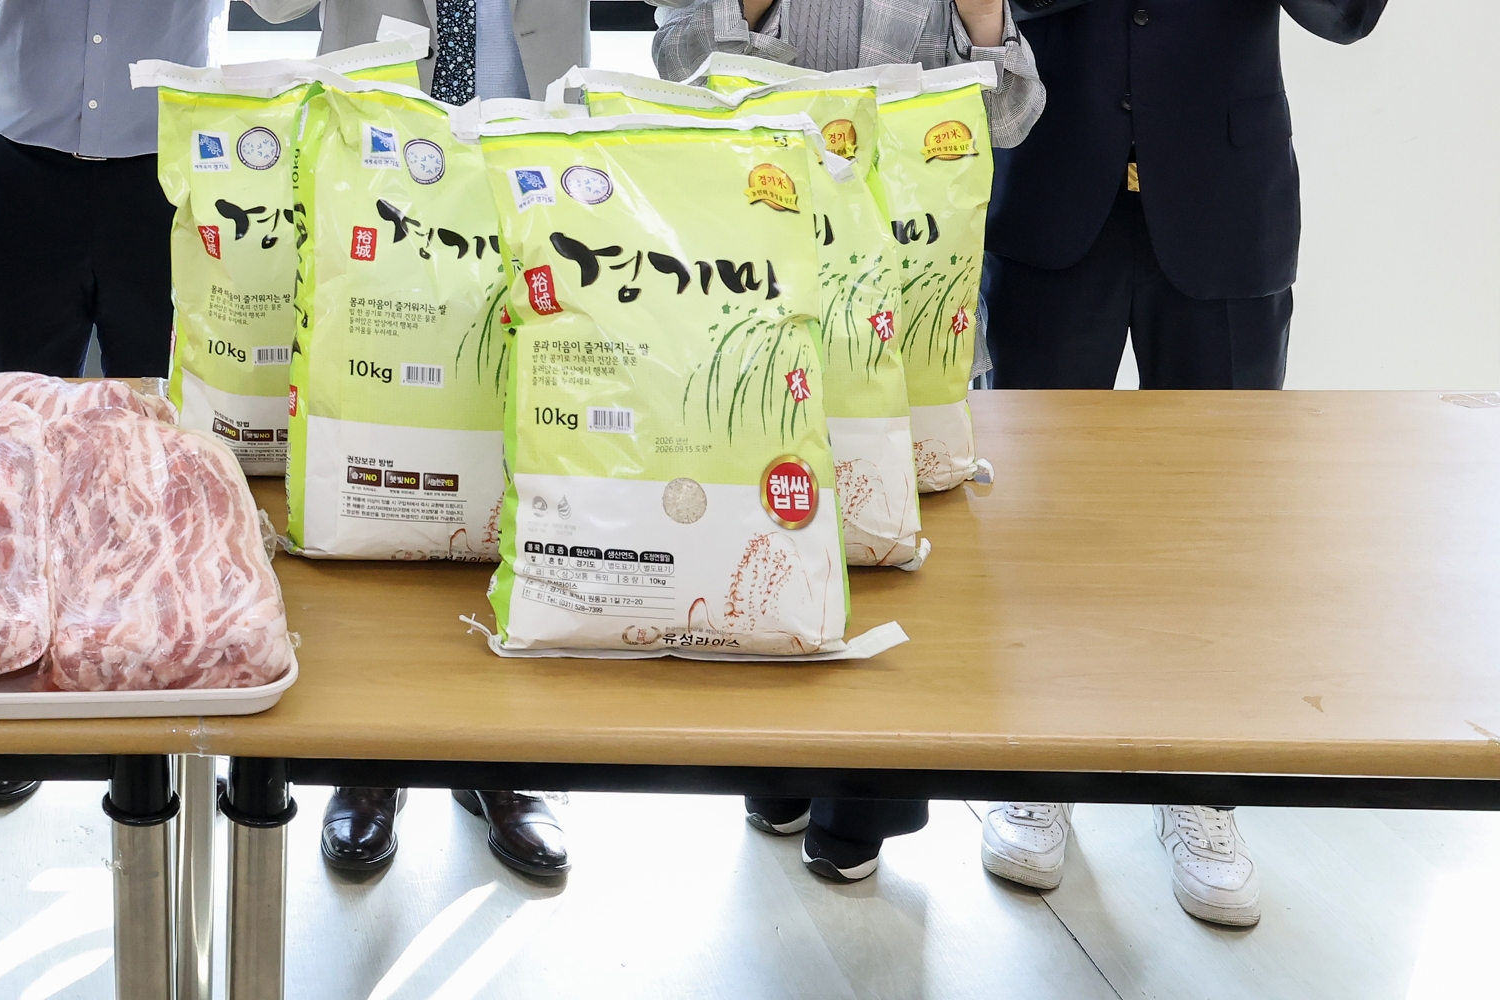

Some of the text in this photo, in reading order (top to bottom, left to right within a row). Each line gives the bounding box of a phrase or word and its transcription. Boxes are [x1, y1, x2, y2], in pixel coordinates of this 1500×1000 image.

[356, 230, 373, 259] 裕城
[549, 231, 781, 303] 경기미
[243, 294, 282, 304] 즐거워지는
[283, 293, 291, 303] 쌀
[531, 272, 556, 312] 裕城
[350, 297, 446, 315] 몸과 마음이 즐거워지는 쌀
[208, 339, 246, 363] 10kg
[533, 340, 650, 356] 몸과 마음이 즐거워지는 쌀
[349, 359, 393, 383] 10kg
[535, 407, 578, 430] 10kg
[655, 437, 674, 445] 2026
[655, 444, 694, 453] 2026.09.15
[769, 474, 810, 510] 햅쌀
[576, 548, 596, 557] 원산지
[607, 551, 635, 560] 생산연도
[576, 559, 596, 568] 경기도
[607, 562, 635, 571] 별도표기
[643, 564, 671, 573] 별도표기
[649, 577, 666, 585] 10kg
[622, 597, 643, 605] 72-20
[662, 633, 740, 647] 유성라이스
